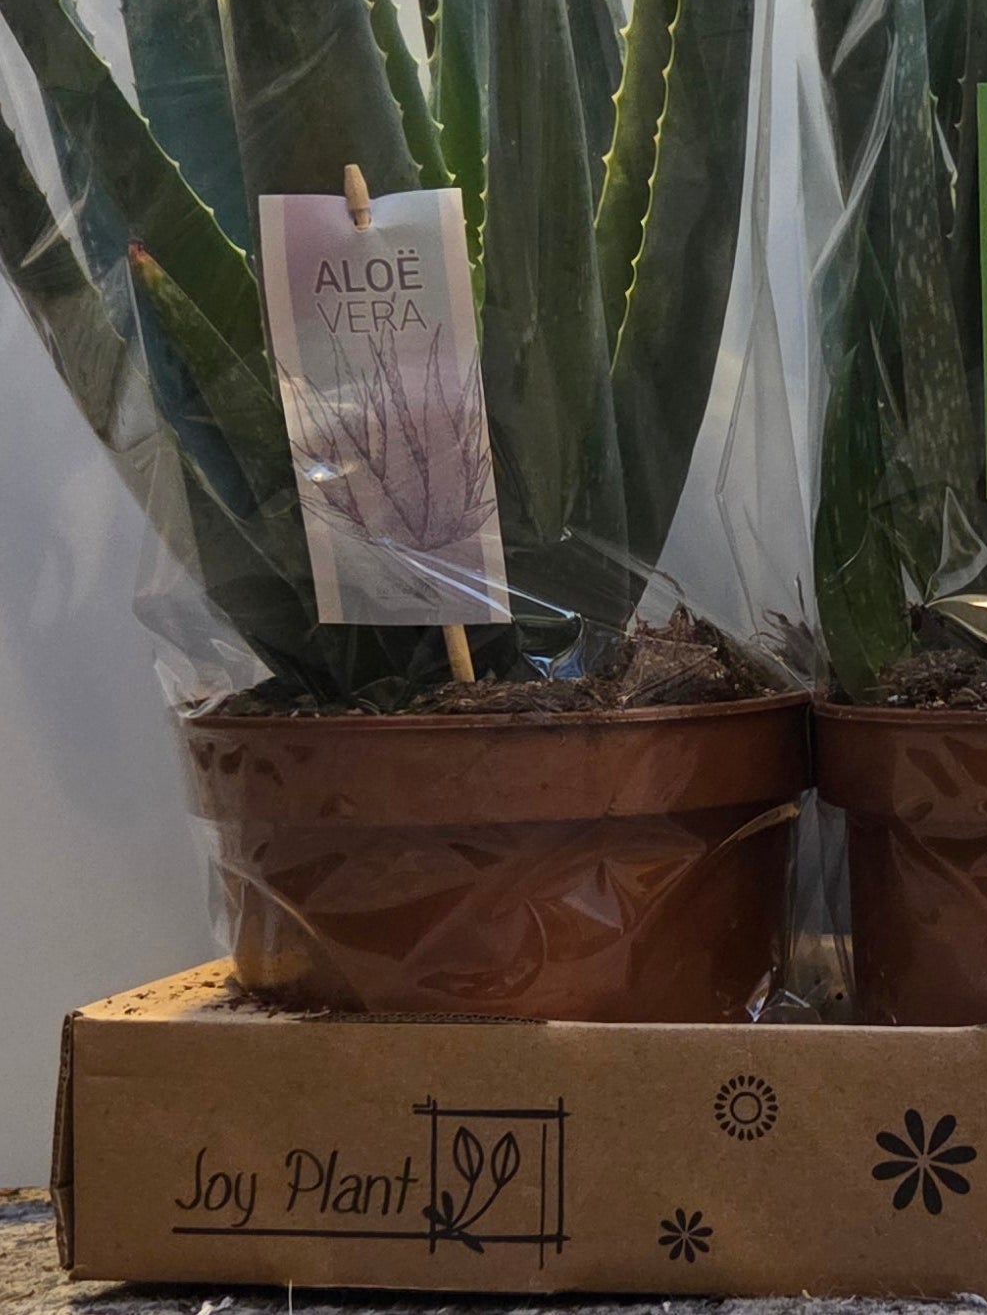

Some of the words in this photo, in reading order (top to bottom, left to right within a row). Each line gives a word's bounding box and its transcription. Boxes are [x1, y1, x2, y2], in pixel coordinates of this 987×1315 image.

[315, 249, 423, 294] ALOË
[316, 299, 428, 334] VERA
[174, 1147, 257, 1228] Joy
[284, 1149, 419, 1216] Plant
